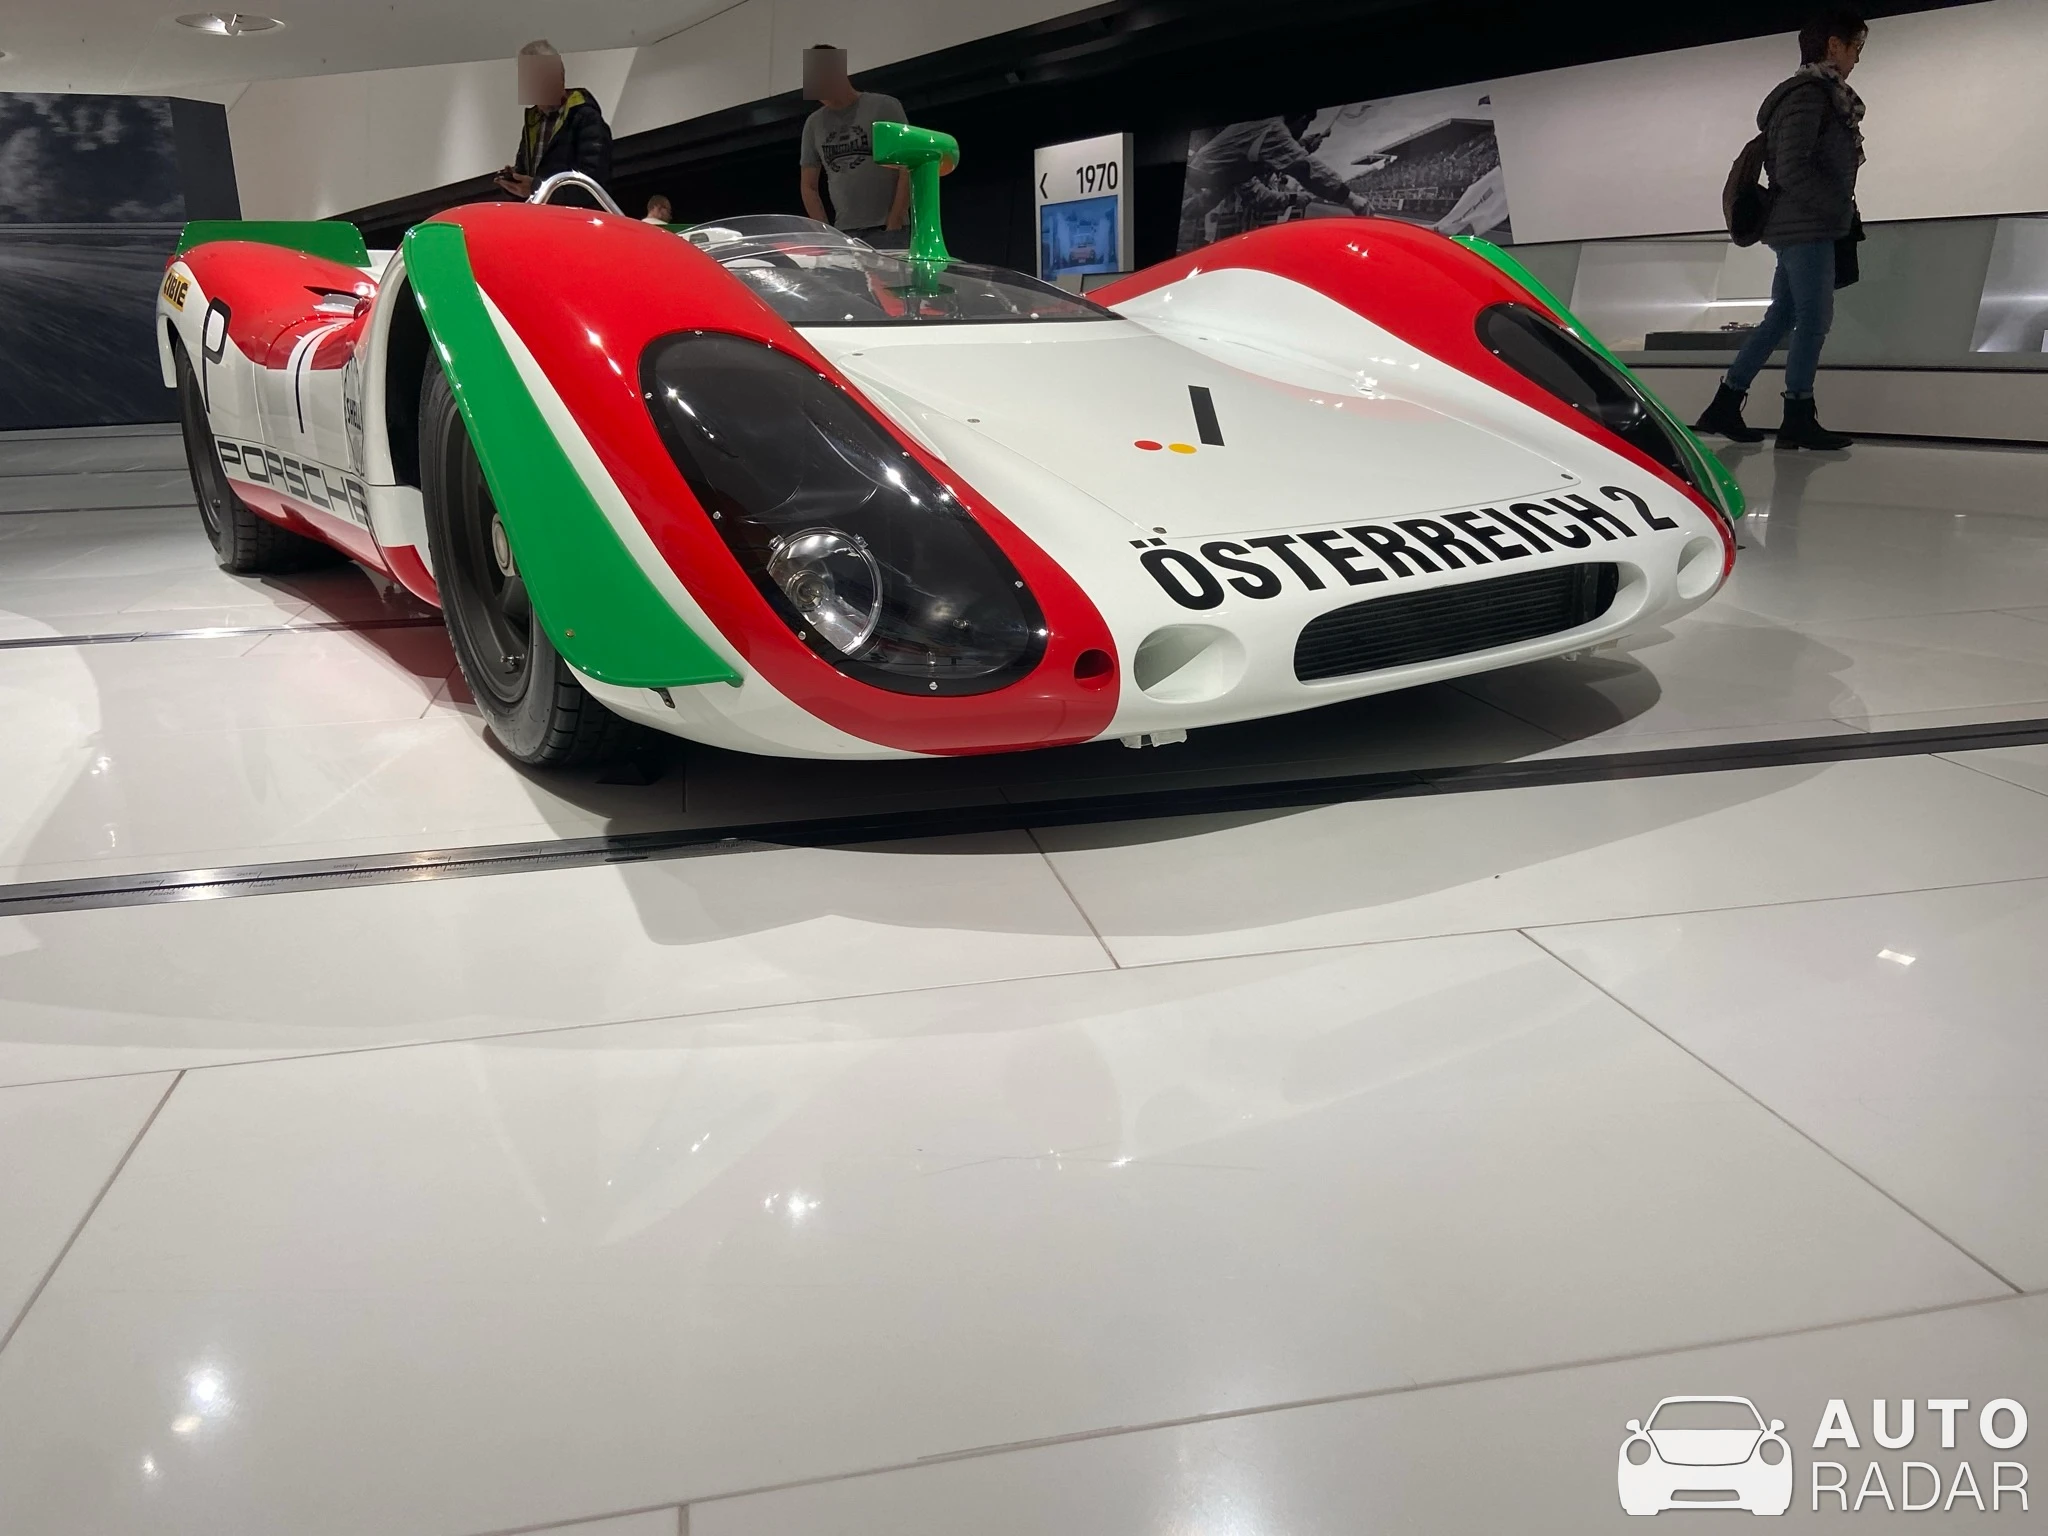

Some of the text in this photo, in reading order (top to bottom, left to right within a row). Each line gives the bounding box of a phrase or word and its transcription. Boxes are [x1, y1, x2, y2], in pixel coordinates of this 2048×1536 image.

[1076, 161, 1118, 194] 1970
[217, 440, 369, 526] PORSCHE
[1130, 485, 1679, 611] ÖSTERREICH 2
